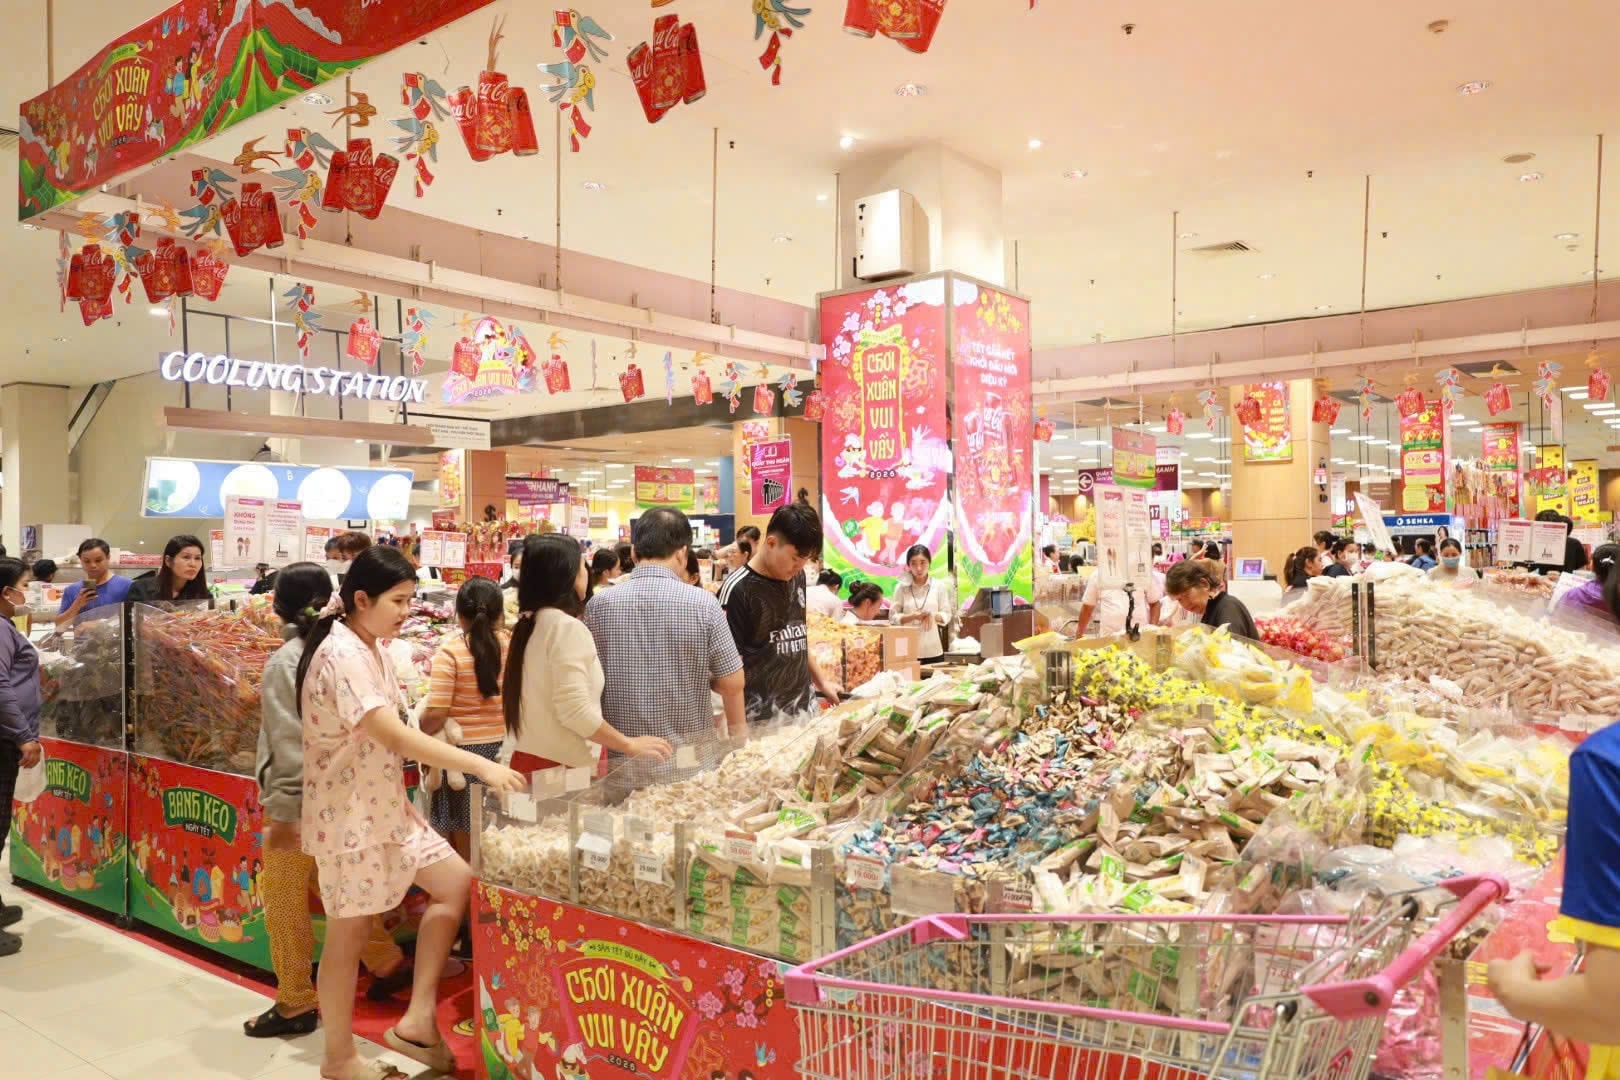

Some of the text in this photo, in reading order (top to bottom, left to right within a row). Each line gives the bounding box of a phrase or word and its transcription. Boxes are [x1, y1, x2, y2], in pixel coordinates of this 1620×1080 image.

[115, 57, 150, 96] XUÂN
[161, 350, 428, 403] COOLING STATION
[866, 374, 897, 401] XUÂN
[869, 407, 894, 430] VUI
[868, 432, 896, 461] VẦY
[869, 470, 896, 480] 2026
[1151, 507, 1159, 518] 17
[565, 964, 684, 1040] CHƠI XUÂN
[577, 1012, 669, 1073] VUI VẦY
[609, 1054, 637, 1072] 2026
